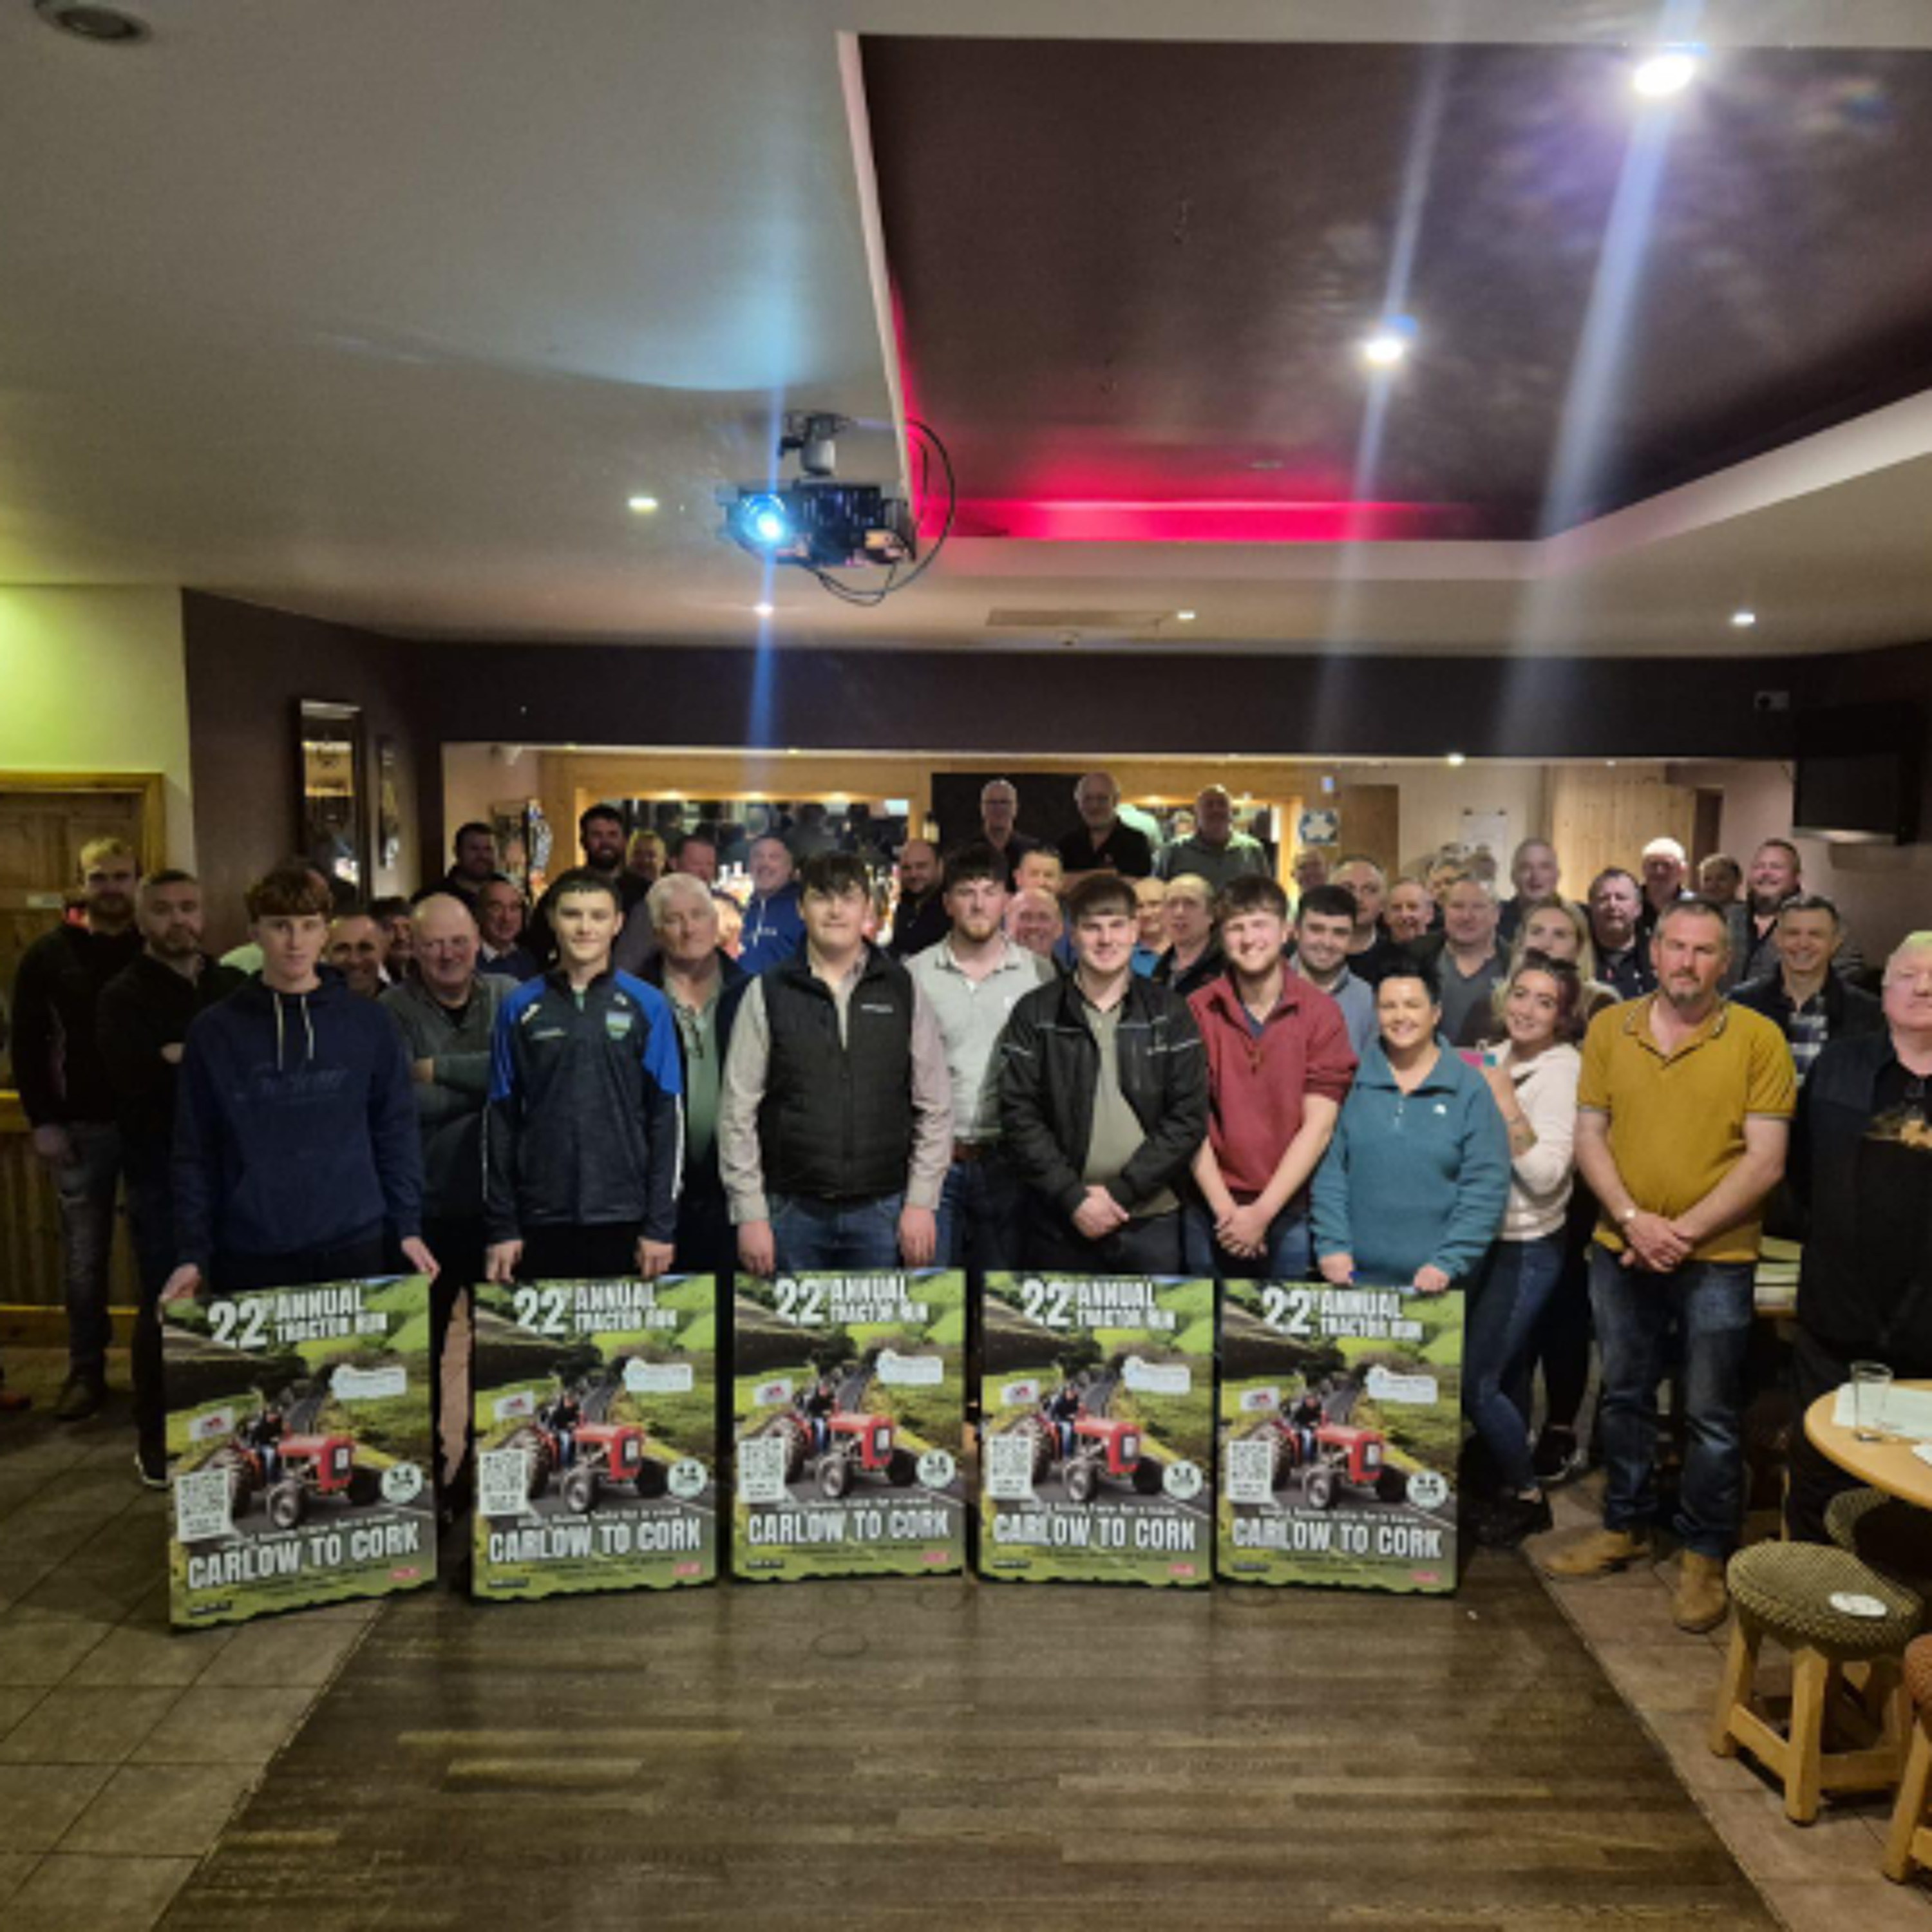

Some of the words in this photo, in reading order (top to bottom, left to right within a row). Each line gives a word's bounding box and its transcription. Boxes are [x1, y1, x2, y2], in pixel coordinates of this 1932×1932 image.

[275, 1288, 365, 1320] ANNUAL
[576, 1284, 657, 1309] ANNUAL
[1077, 1282, 1155, 1307] ANNUAL
[1321, 1290, 1402, 1318] ANNUAL
[489, 1525, 592, 1562] CARLOW
[599, 1522, 630, 1553] TO
[638, 1518, 700, 1549] CORK
[749, 1510, 847, 1543] CARLOW
[853, 1510, 881, 1539] TO
[889, 1510, 949, 1539] CORK
[994, 1513, 1090, 1546] CARLOW
[1098, 1517, 1126, 1546] TO
[1135, 1518, 1195, 1551] CORK
[1233, 1518, 1331, 1551] CARLOW
[1340, 1524, 1368, 1554] TO
[1379, 1526, 1442, 1558] CORK
[188, 1542, 301, 1588] CARLOW
[312, 1536, 341, 1566] TO
[352, 1522, 419, 1560] CORK
